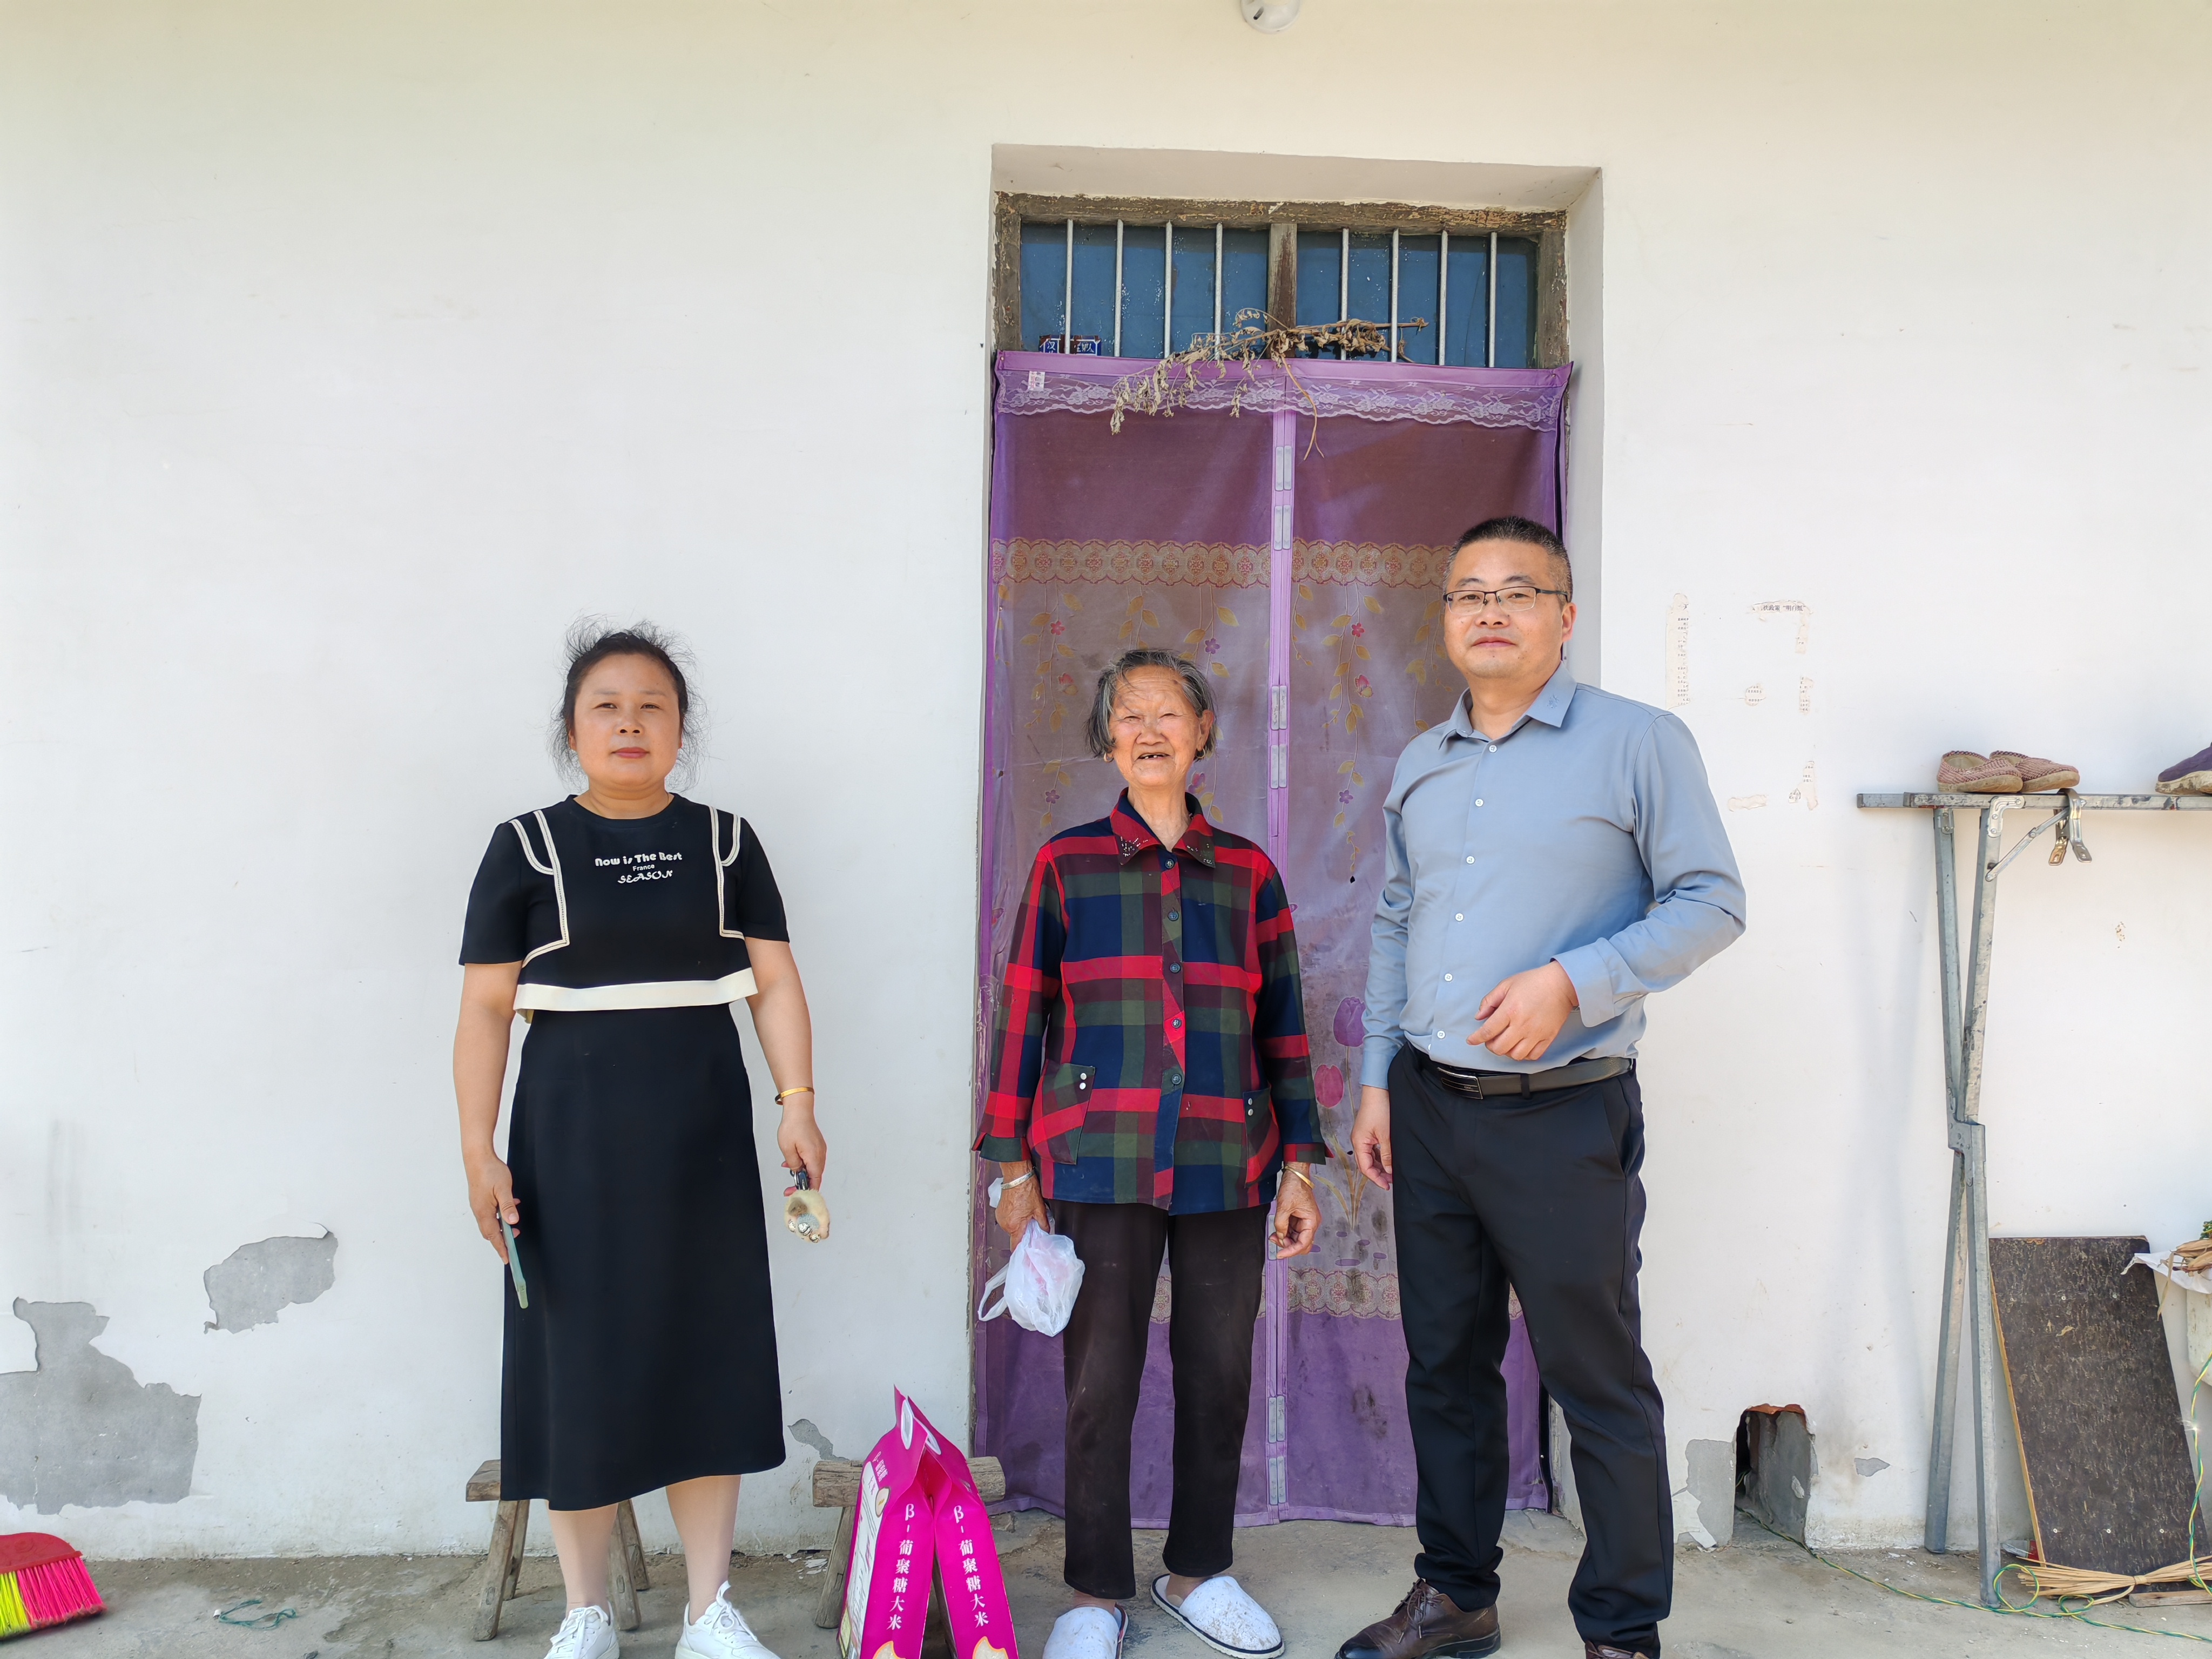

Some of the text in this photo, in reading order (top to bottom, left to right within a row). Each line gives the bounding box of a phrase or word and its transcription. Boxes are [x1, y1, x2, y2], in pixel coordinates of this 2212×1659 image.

[623, 856, 633, 865] is
[634, 853, 657, 864] The
[658, 852, 683, 861] Best
[632, 864, 655, 872] France
